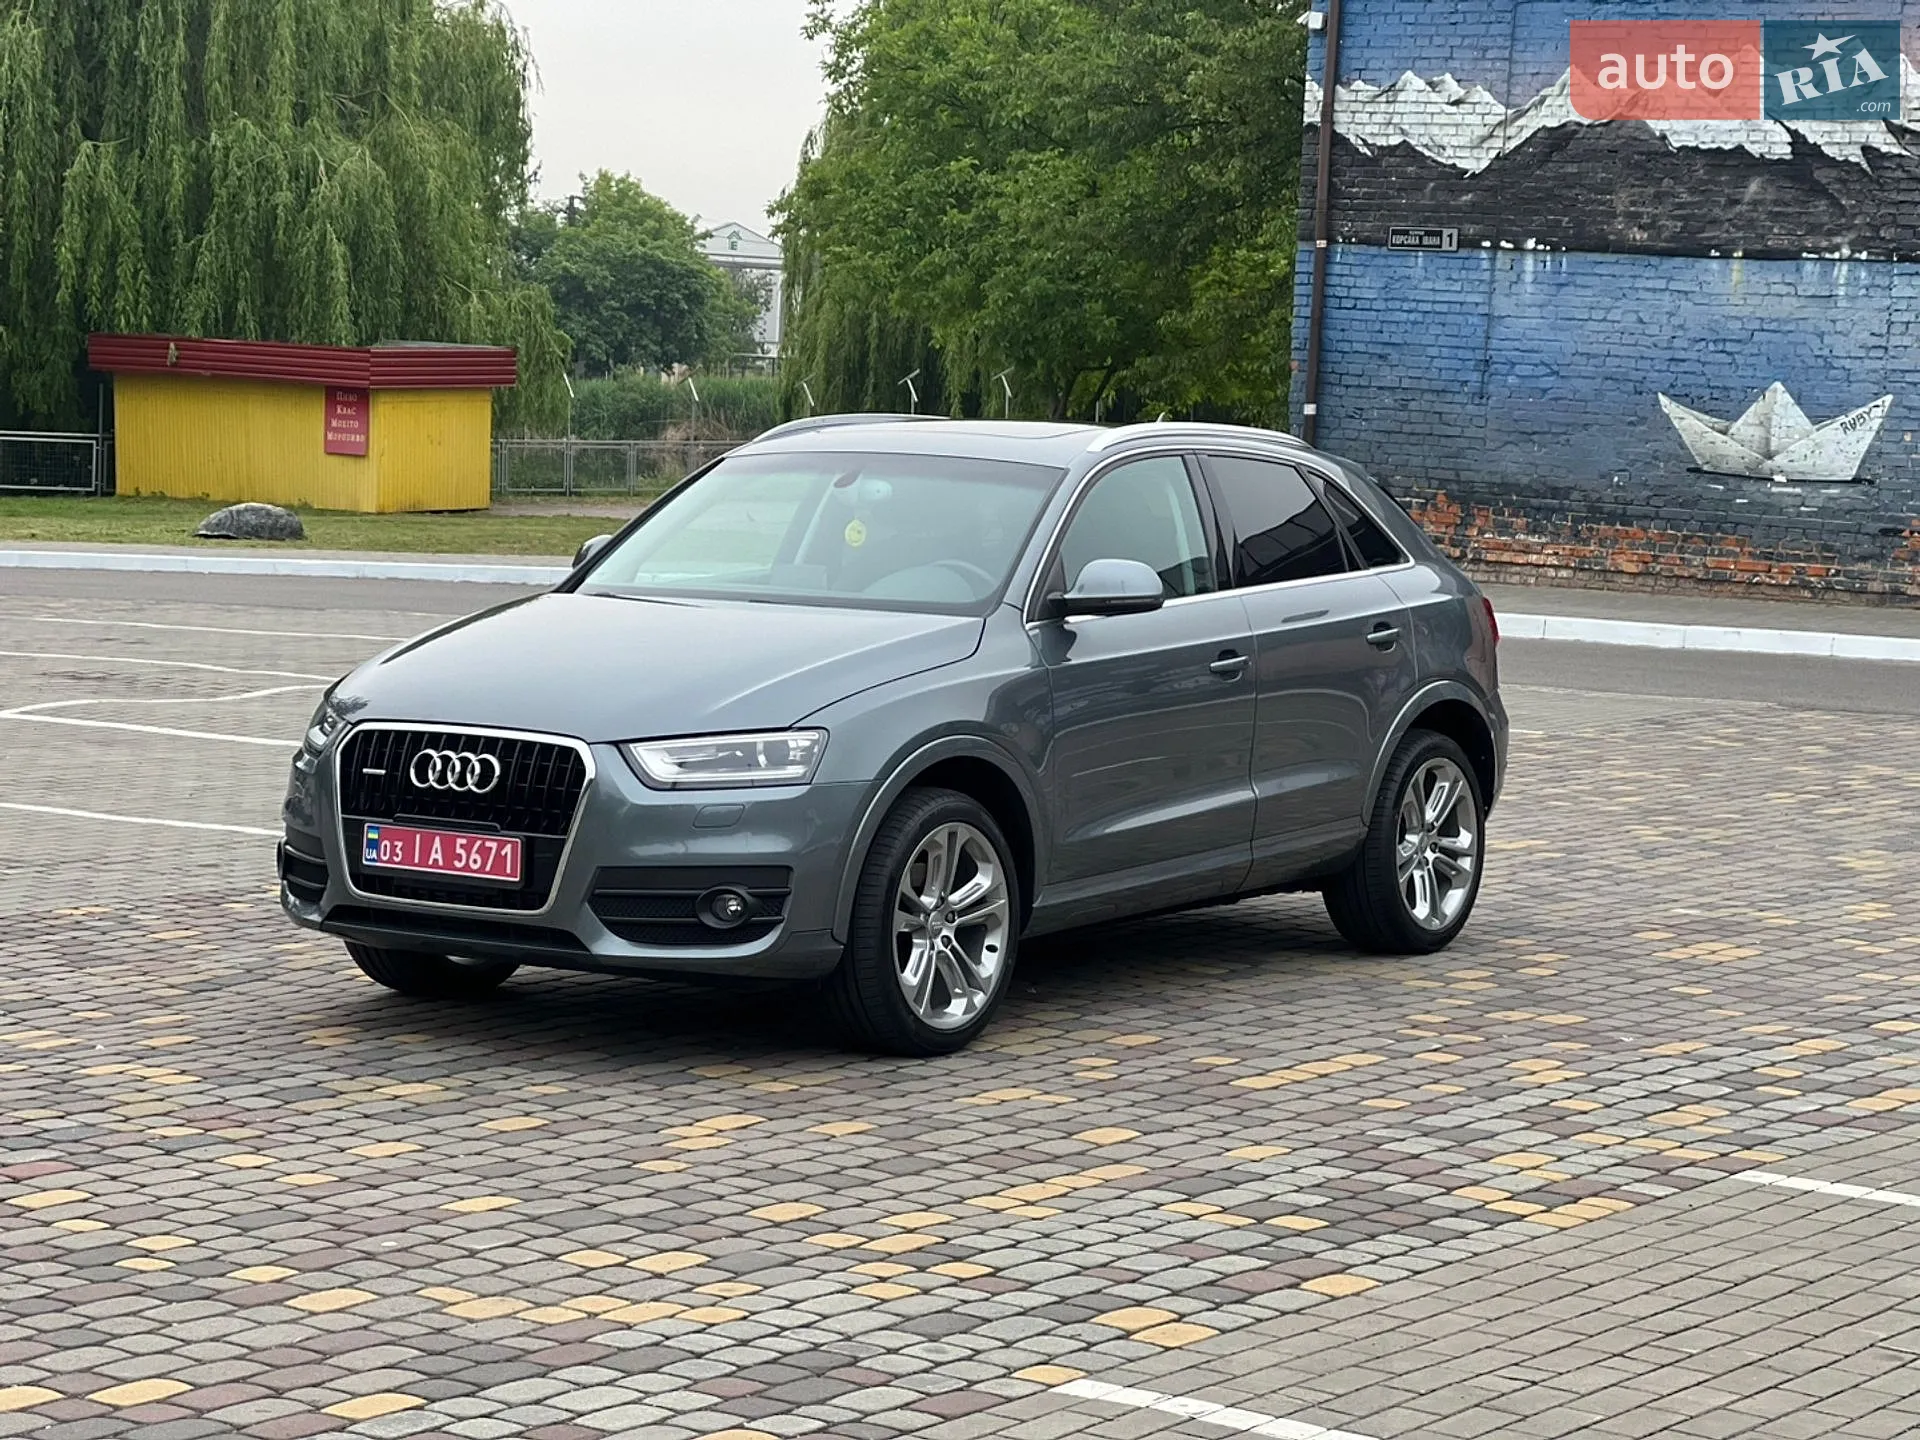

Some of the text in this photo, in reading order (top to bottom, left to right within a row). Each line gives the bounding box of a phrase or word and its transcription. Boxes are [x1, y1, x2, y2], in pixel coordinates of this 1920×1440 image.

[1447, 232, 1453, 247] 1
[365, 847, 378, 860] UA
[380, 833, 512, 874] 03 IA 5671
